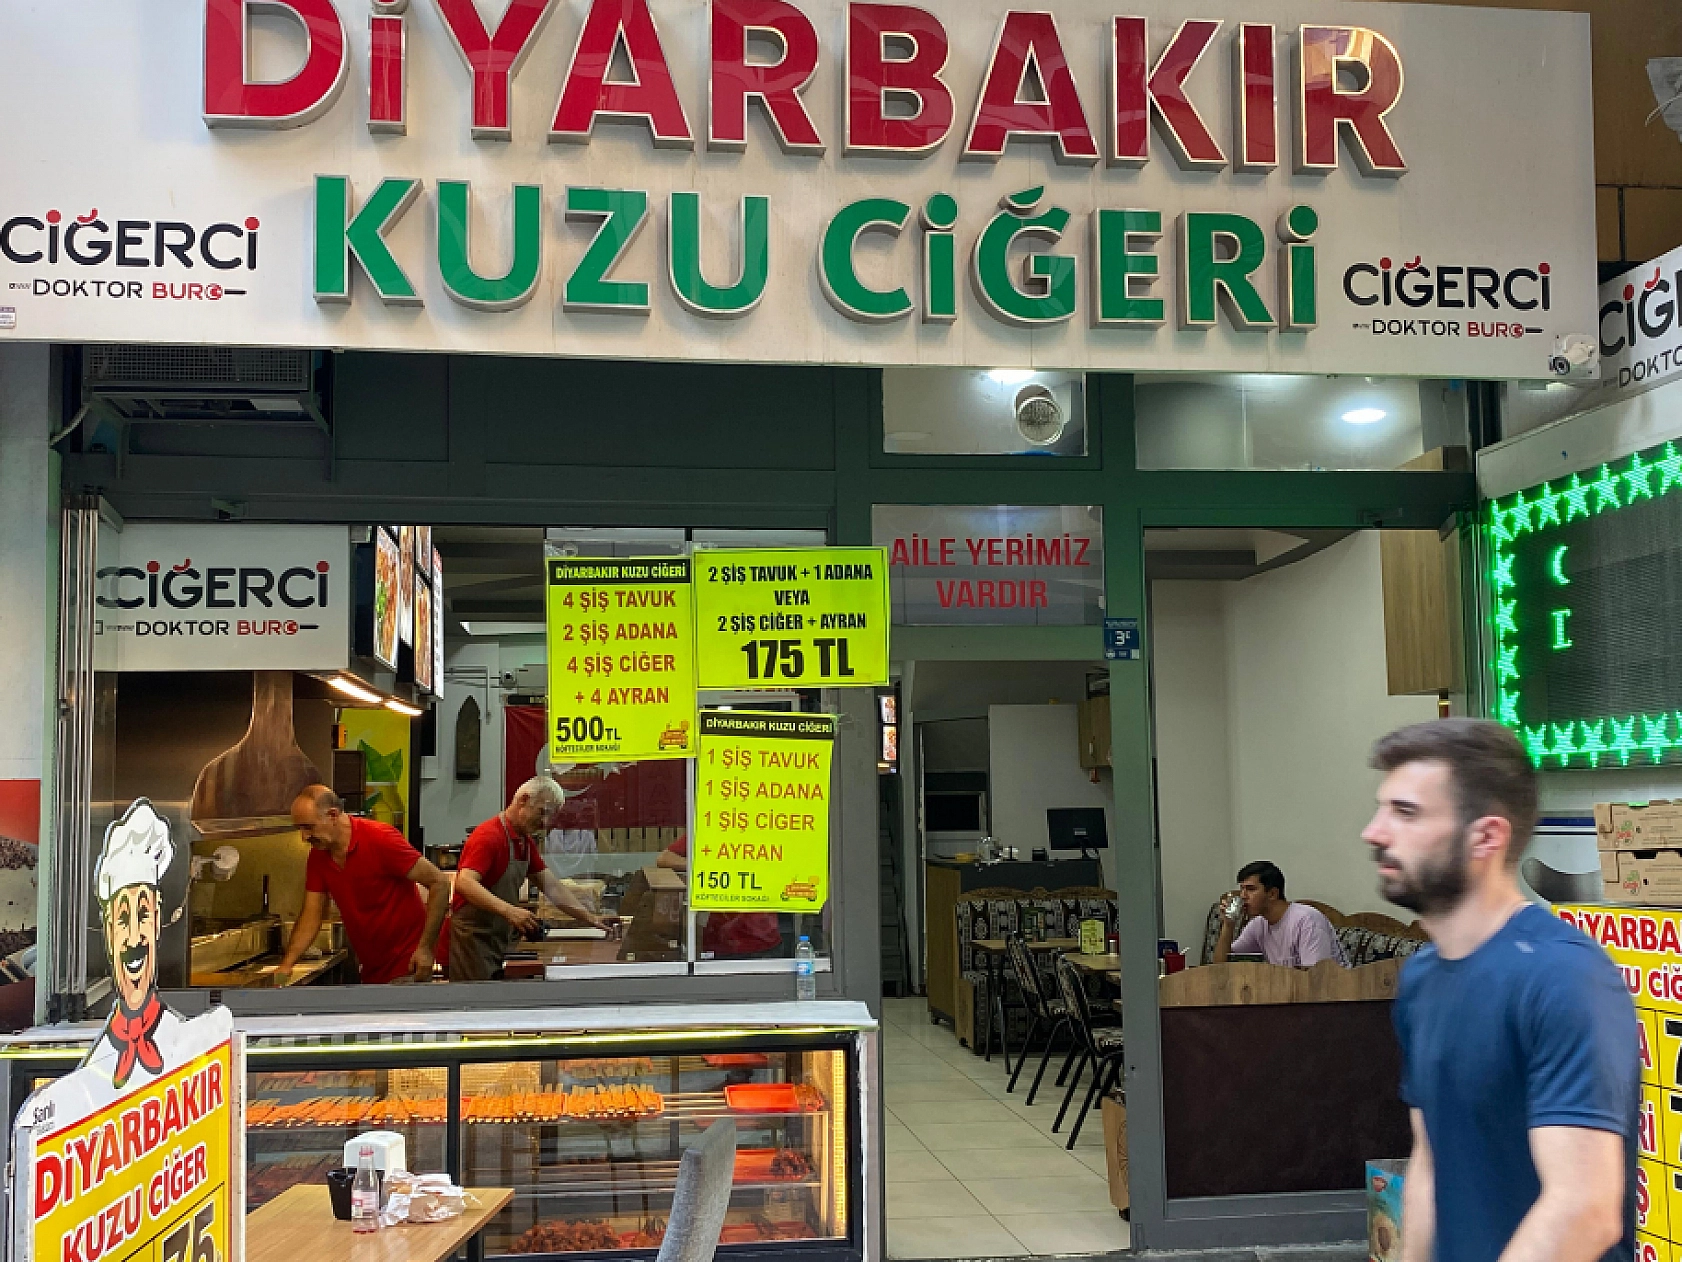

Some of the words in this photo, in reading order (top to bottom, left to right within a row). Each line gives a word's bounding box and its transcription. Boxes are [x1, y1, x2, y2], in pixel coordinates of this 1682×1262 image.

[313, 174, 771, 319] KUZU
[33, 279, 143, 299] DOKTOR
[1372, 319, 1461, 337] DOKTOR
[891, 533, 955, 566] AİLE
[966, 533, 1091, 566] YERİMİZ
[708, 566, 719, 582] 2
[721, 563, 747, 585] ŞİŞ
[749, 565, 799, 581] TAVUK
[813, 565, 822, 580] 1
[824, 564, 873, 580] ADANA
[563, 591, 574, 610] 4
[580, 587, 610, 613] ŞİŞ
[615, 590, 677, 608] TAVUK
[774, 589, 811, 606] VEYA
[937, 580, 1048, 608] VARDIR
[135, 620, 230, 636] DOKTOR
[563, 623, 575, 641] 2
[580, 620, 610, 646] ŞİŞ
[615, 622, 679, 640] ADANA
[717, 616, 729, 632] 2
[730, 613, 756, 635] ŞİŞ
[759, 611, 803, 630] CİĞER
[820, 613, 867, 630] AYRAN
[567, 656, 578, 674] 4
[584, 651, 614, 678] ŞİŞ
[619, 650, 676, 673] CİĞER
[741, 639, 805, 680] 175
[813, 637, 855, 678] TL
[591, 688, 602, 706] 4
[607, 686, 670, 706] AYRAN
[556, 715, 605, 742] 500
[605, 728, 623, 741] TL
[707, 748, 715, 765] 1
[722, 745, 752, 772] ŞİŞ
[758, 750, 820, 770] TAVUK
[705, 779, 713, 796] 1
[720, 776, 750, 803] ŞİŞ
[756, 781, 824, 800] ADANA
[704, 810, 711, 827] 1
[718, 807, 749, 834] ŞİŞ
[716, 842, 783, 862] AYRAN
[696, 870, 730, 889] 150
[737, 871, 762, 891] TL
[63, 1187, 142, 1262] KUZU
